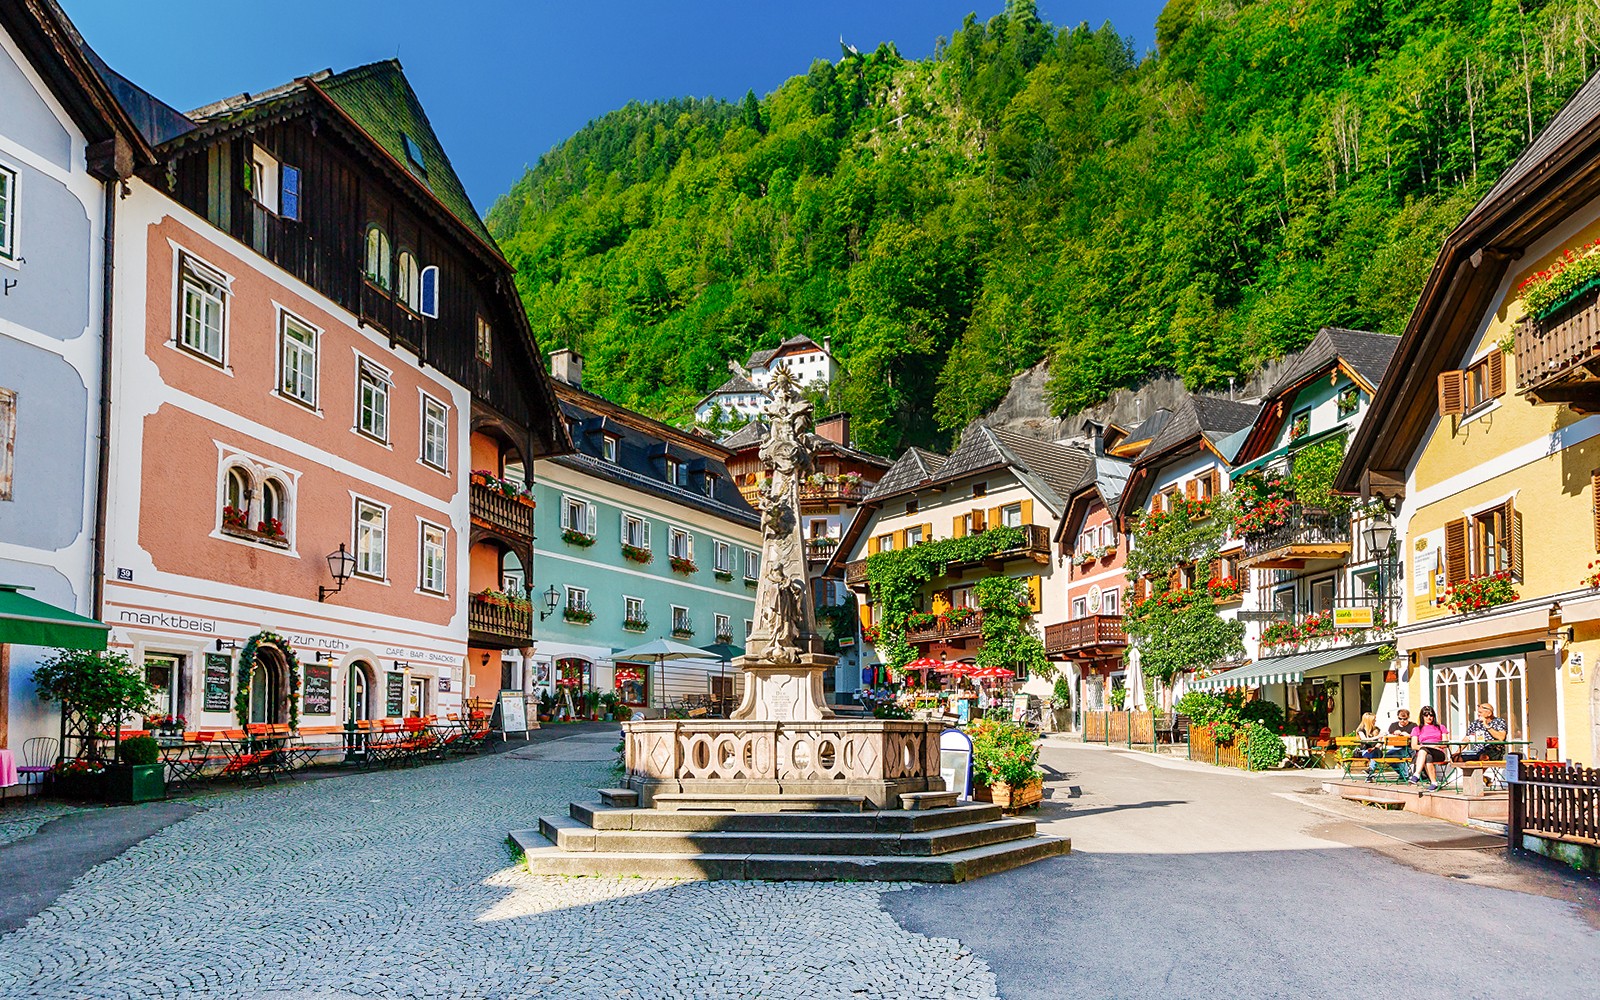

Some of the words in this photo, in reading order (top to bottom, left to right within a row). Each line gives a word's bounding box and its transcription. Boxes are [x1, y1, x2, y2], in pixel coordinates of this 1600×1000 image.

[120, 569, 131, 577] 59
[120, 610, 216, 632] marktbeisl
[386, 647, 404, 657] CAFÉ
[410, 650, 424, 658] BAR
